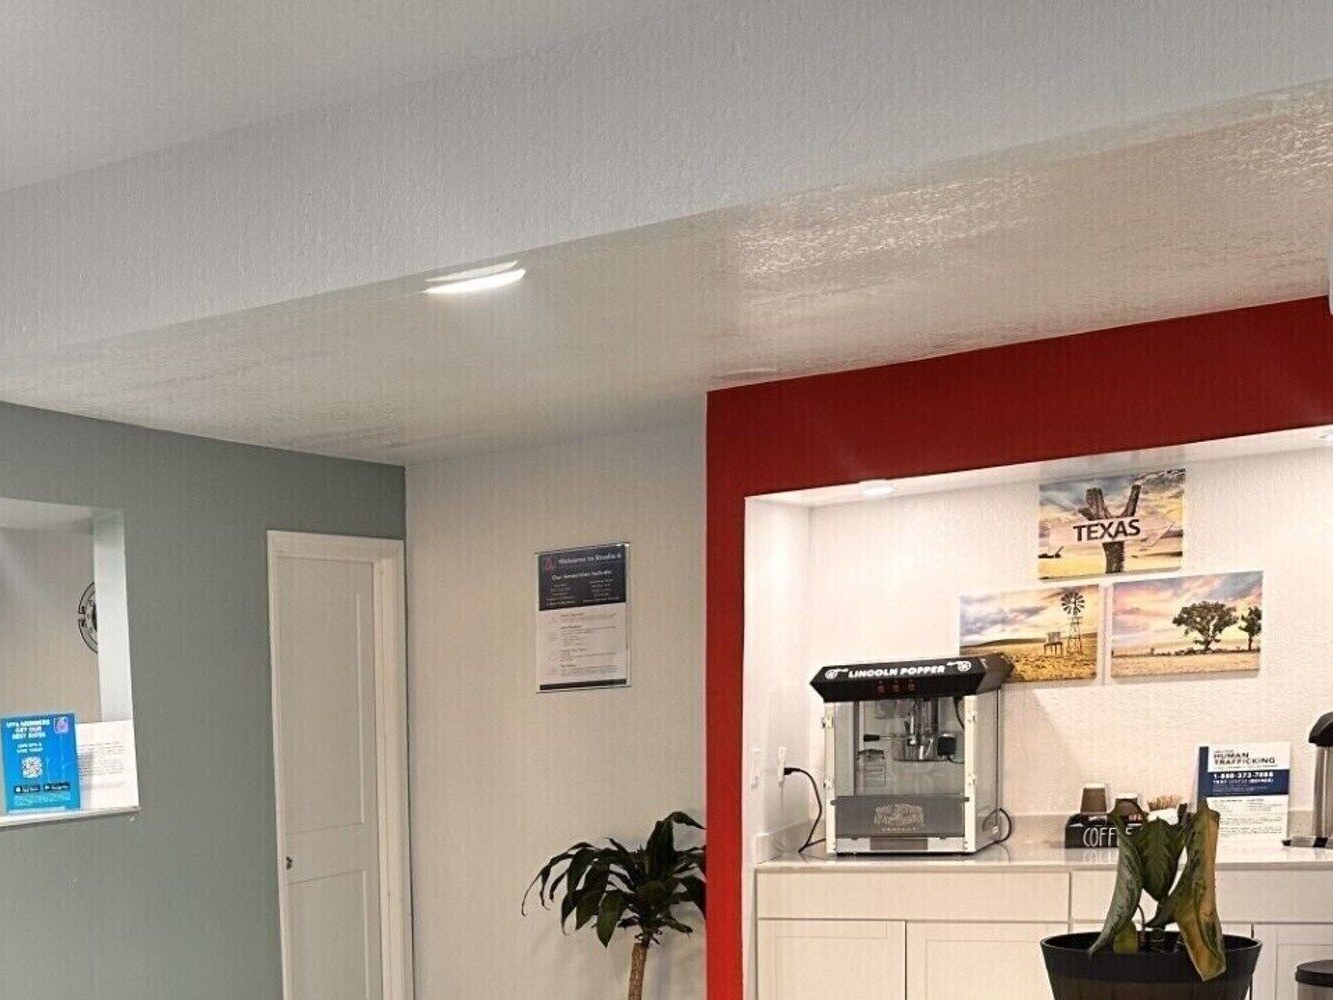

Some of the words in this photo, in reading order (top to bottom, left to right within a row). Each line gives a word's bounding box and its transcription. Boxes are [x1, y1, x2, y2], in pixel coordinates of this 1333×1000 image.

[1072, 518, 1141, 541] TEXAS
[848, 667, 898, 679] LINCOLN
[899, 665, 945, 676] POPPER
[1213, 757, 1276, 765] TRAFFICKING
